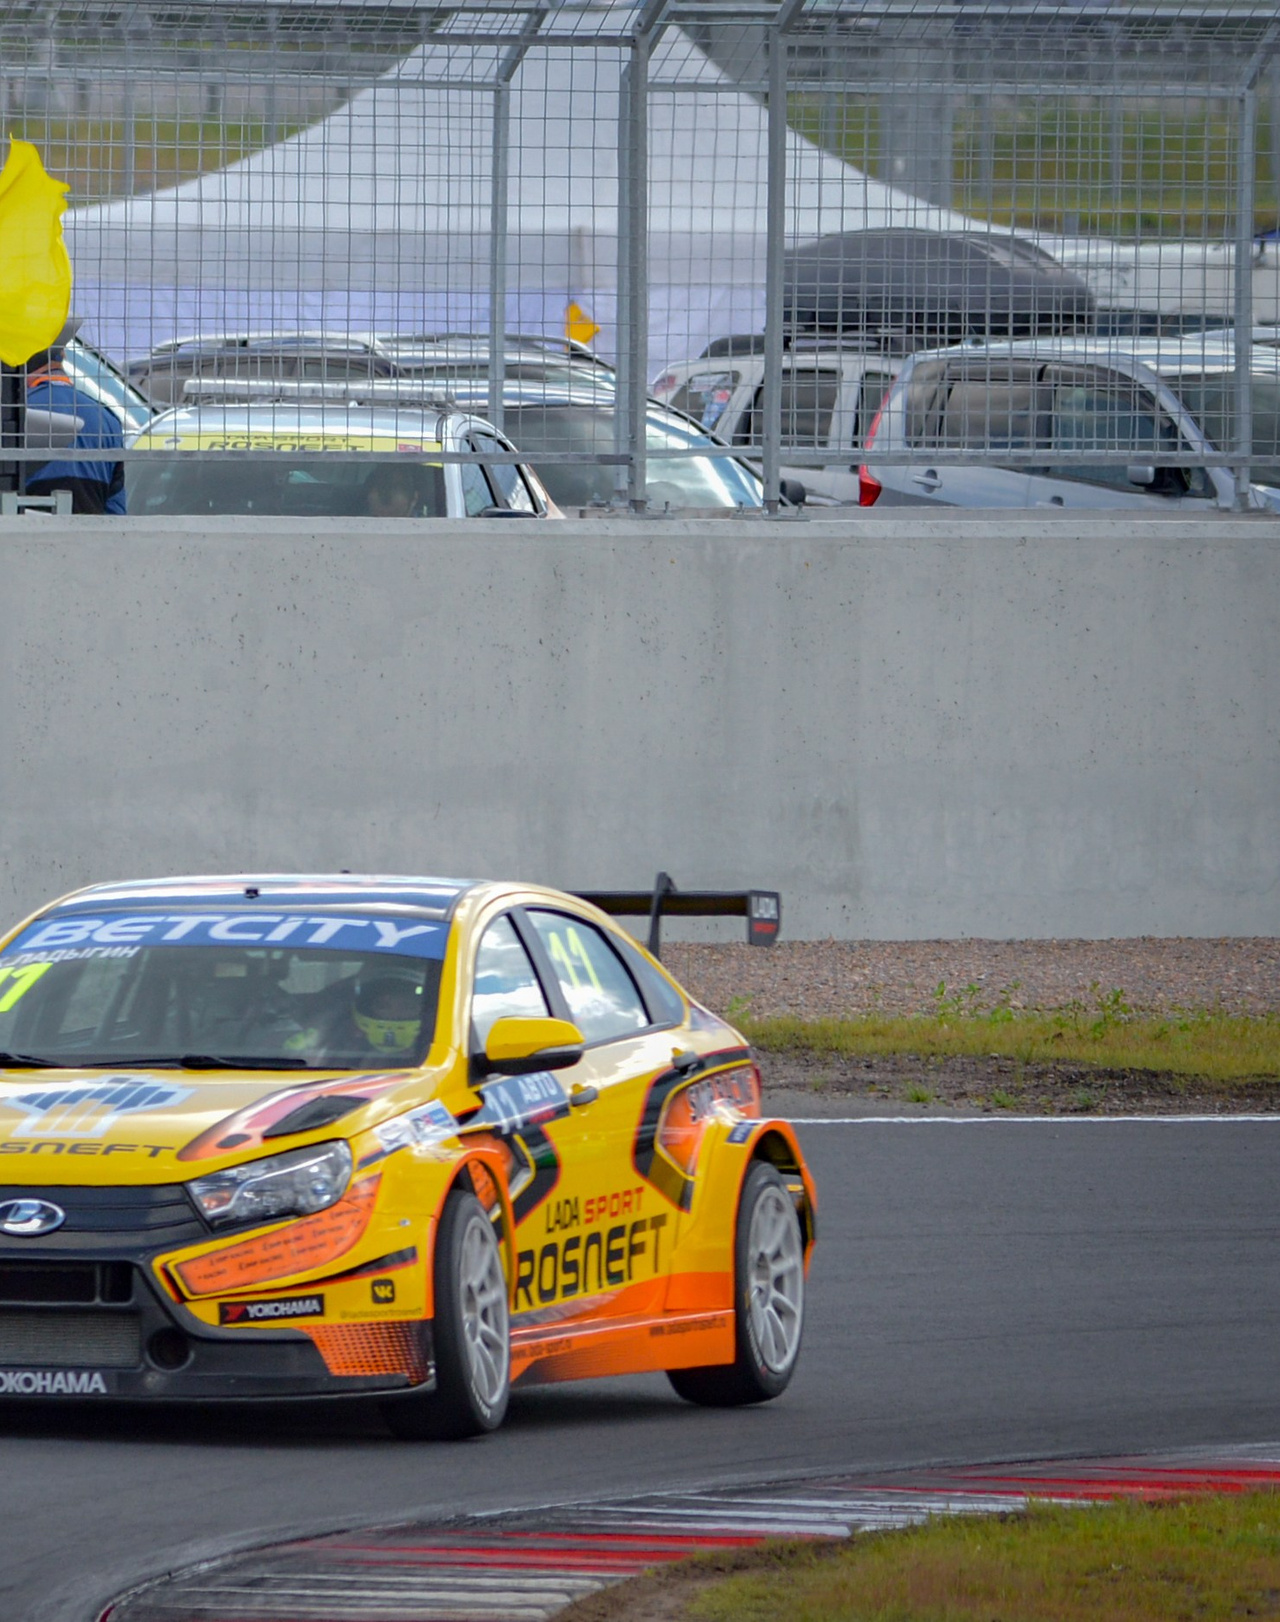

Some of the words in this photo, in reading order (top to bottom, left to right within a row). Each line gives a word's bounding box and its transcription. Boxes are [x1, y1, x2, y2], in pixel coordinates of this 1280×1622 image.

[21, 915, 439, 949] BETCITY
[548, 926, 603, 995] 11
[484, 1085, 522, 1135] 11
[546, 1197, 580, 1234] LADA
[584, 1186, 645, 1224] SPORT
[514, 1213, 668, 1311] ROSNEFT
[246, 1299, 321, 1319] YOKOHAMA
